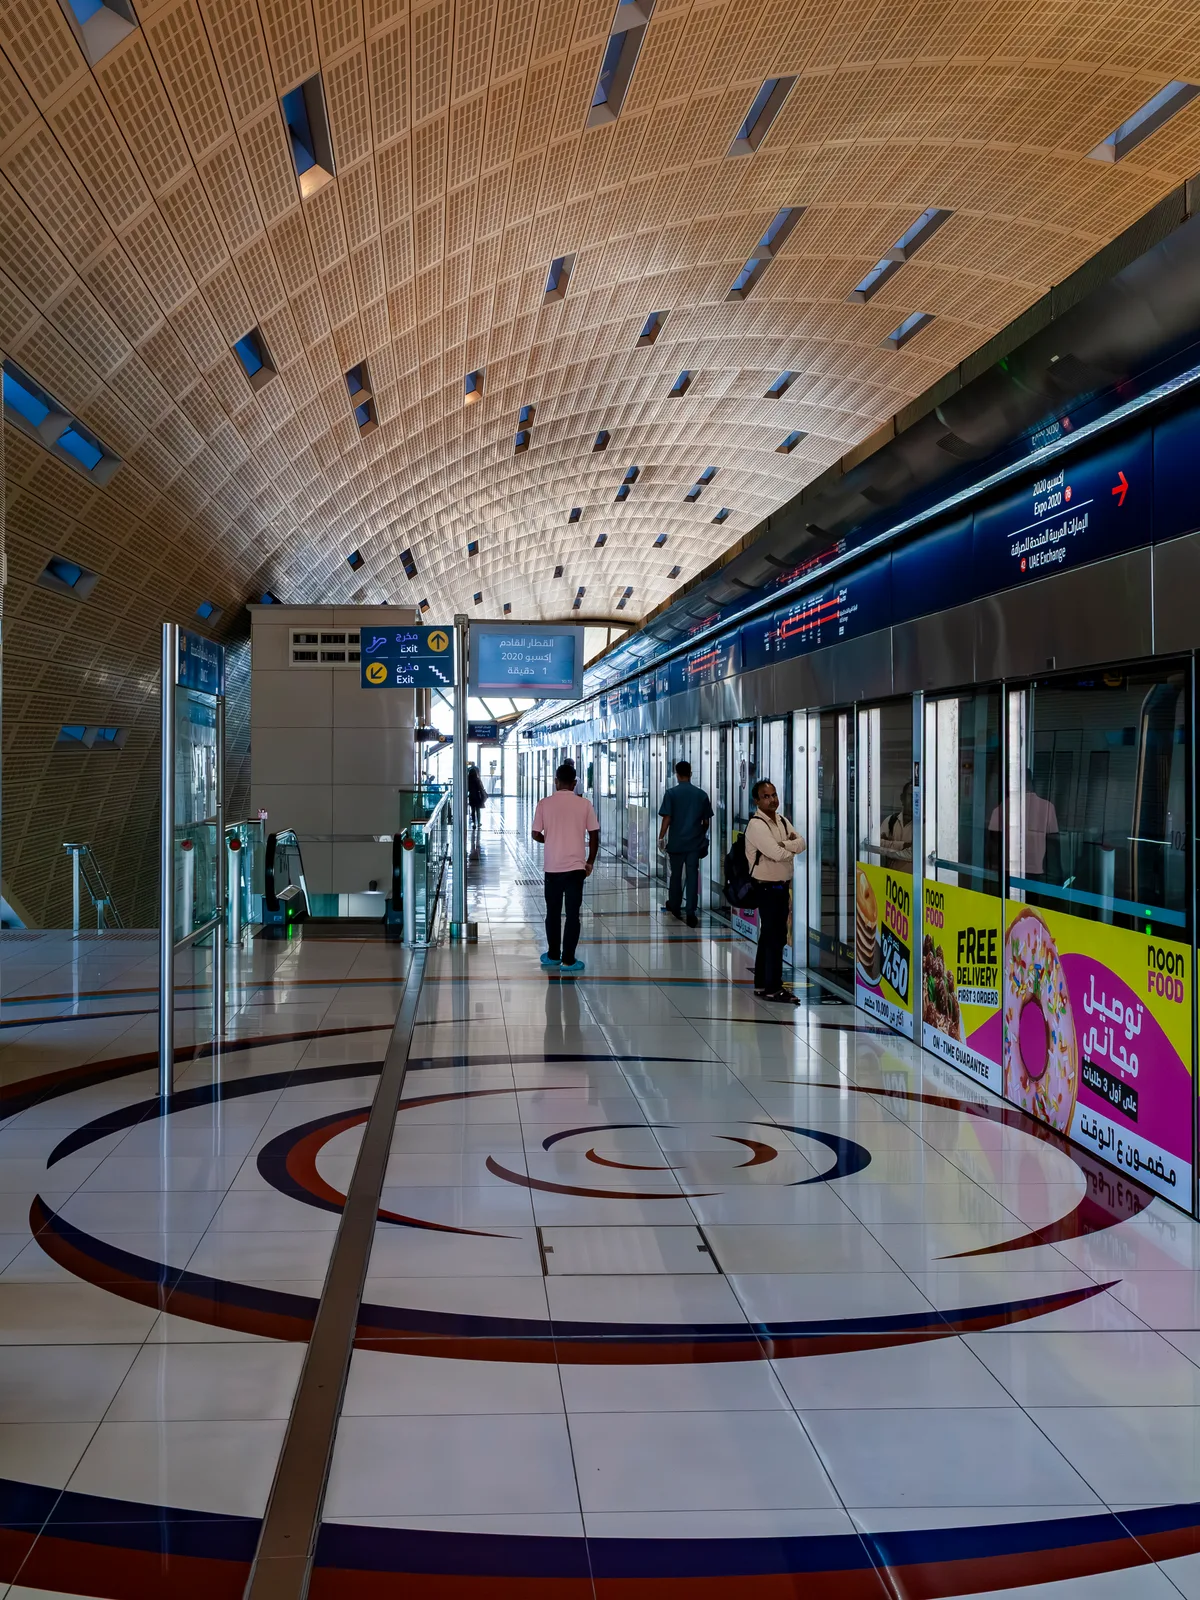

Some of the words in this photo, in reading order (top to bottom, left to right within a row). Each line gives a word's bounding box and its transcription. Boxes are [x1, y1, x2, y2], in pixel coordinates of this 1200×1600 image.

[1033, 478, 1046, 496] 2020
[1034, 501, 1047, 517] Expo
[1047, 491, 1061, 509] 2020
[1030, 528, 1049, 549] المتحدة
[1049, 521, 1068, 544] العربية
[1029, 552, 1040, 569] UAE
[1040, 546, 1066, 563] Exchange
[395, 632, 418, 642] مخرج
[499, 638, 526, 648] القادم
[526, 639, 554, 648] القطار
[400, 644, 418, 653] Exit
[501, 652, 523, 660] 2020
[525, 652, 552, 663] إكسبو
[396, 662, 419, 673] مخرج
[507, 666, 535, 676] دقيقة
[396, 675, 414, 684] Exit
[885, 874, 910, 916] noon
[925, 888, 944, 911] noon
[885, 900, 908, 942] FOOD
[925, 907, 944, 929] FOOD
[957, 926, 998, 965] FREE
[1147, 944, 1184, 978] noon
[957, 966, 998, 987] DELIVERY
[1147, 970, 1184, 1004] FOOD
[957, 989, 972, 1003] FIRST
[976, 991, 998, 1006] ORDERS
[1083, 974, 1144, 1040] توصيل
[1082, 1026, 1139, 1078] مجاني
[955, 1048, 989, 1079] GUARANTEE
[1083, 1065, 1102, 1089] طلبات
[1102, 1077, 1108, 1093] 3
[1108, 1084, 1122, 1104] أول
[1122, 1093, 1137, 1113] على
[1080, 1113, 1115, 1151] الوقت
[1117, 1139, 1123, 1165] ع
[1125, 1144, 1176, 1187] مضمون
